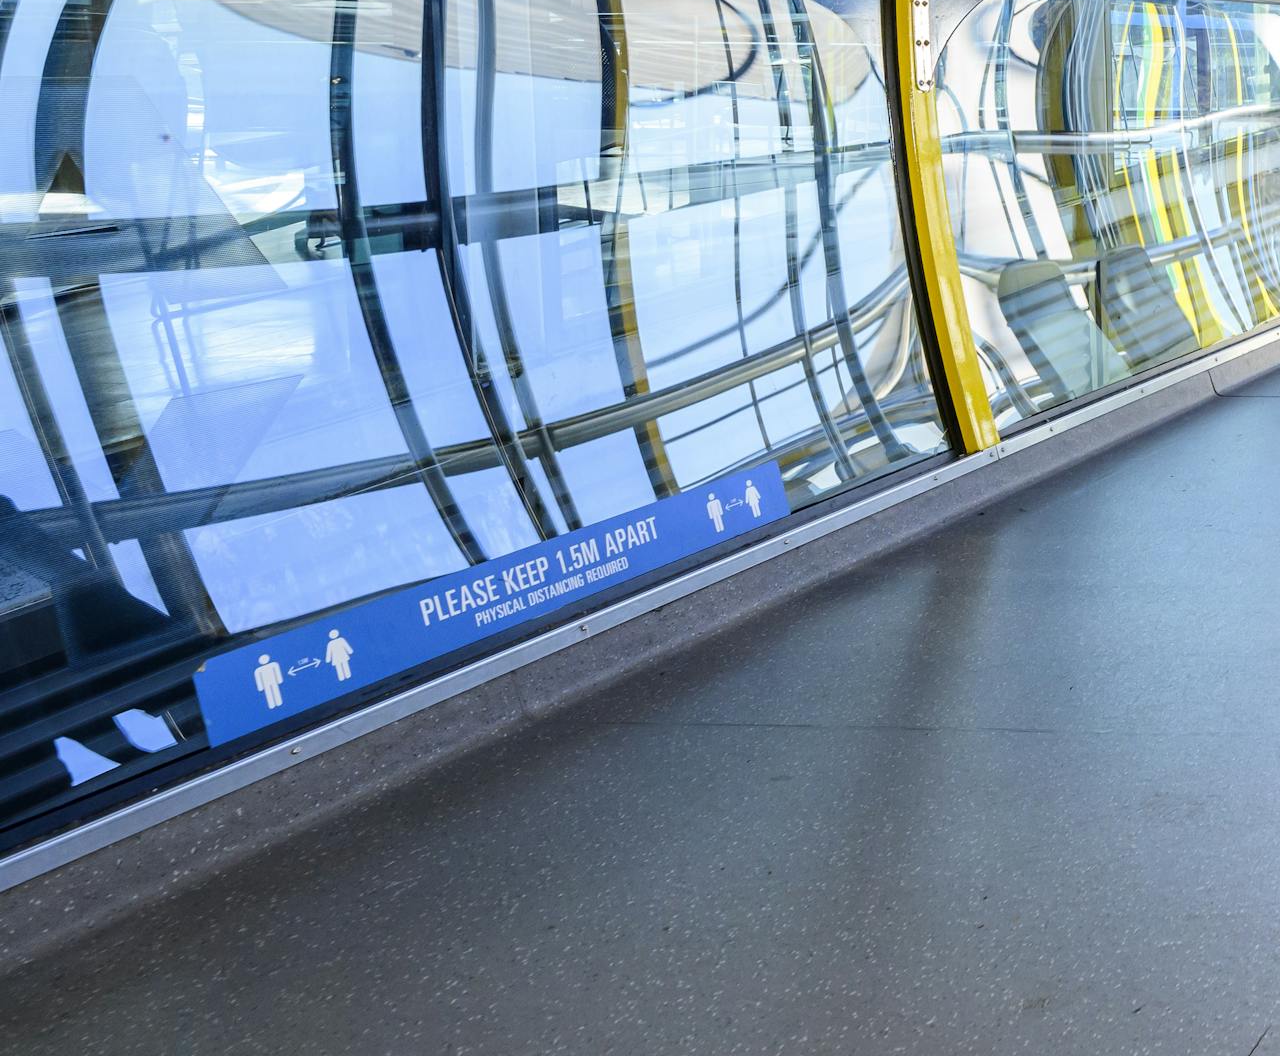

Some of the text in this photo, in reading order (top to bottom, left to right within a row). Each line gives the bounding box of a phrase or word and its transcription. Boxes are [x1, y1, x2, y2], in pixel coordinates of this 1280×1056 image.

[419, 516, 659, 627] PLEASE KEEP 1.5M APART
[474, 556, 629, 628] PHYSICAL DISTANCING REQUIRED
